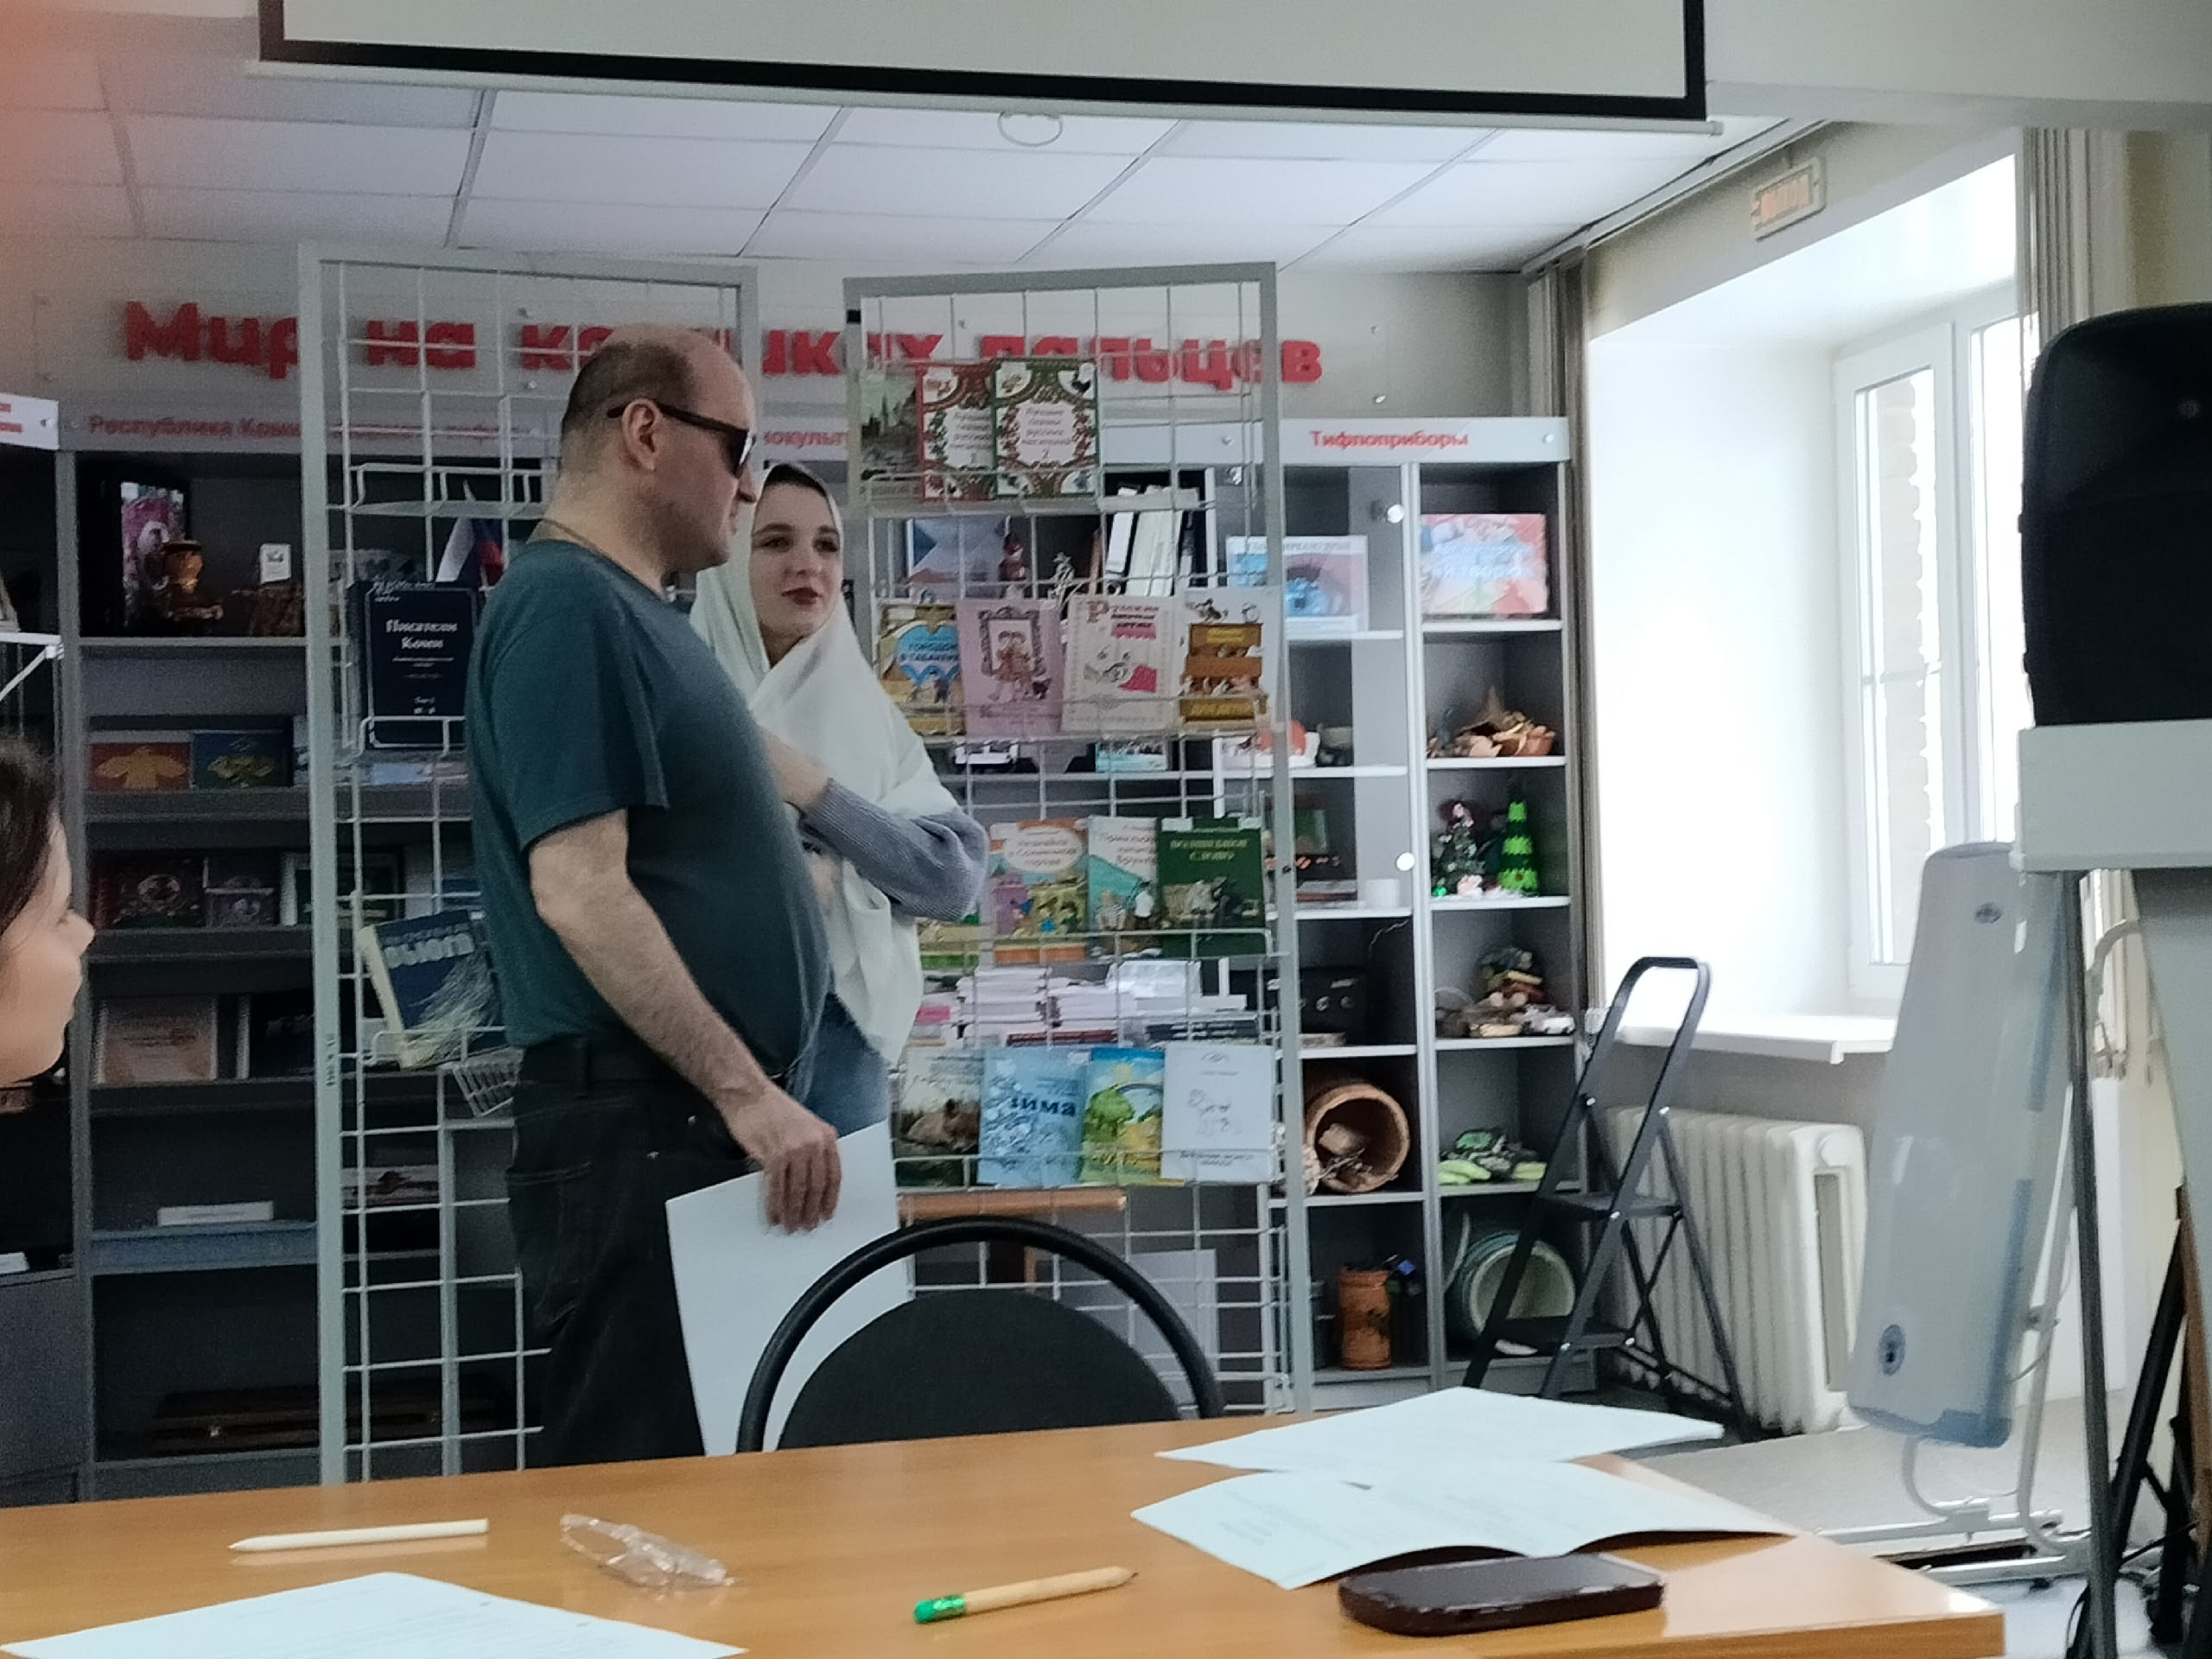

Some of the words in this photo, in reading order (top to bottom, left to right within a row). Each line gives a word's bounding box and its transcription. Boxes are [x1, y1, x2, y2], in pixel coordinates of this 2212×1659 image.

[126, 301, 297, 379] Мир
[366, 320, 476, 369] на
[89, 414, 232, 440] Республика
[1310, 429, 1470, 450] Тифлоприборы
